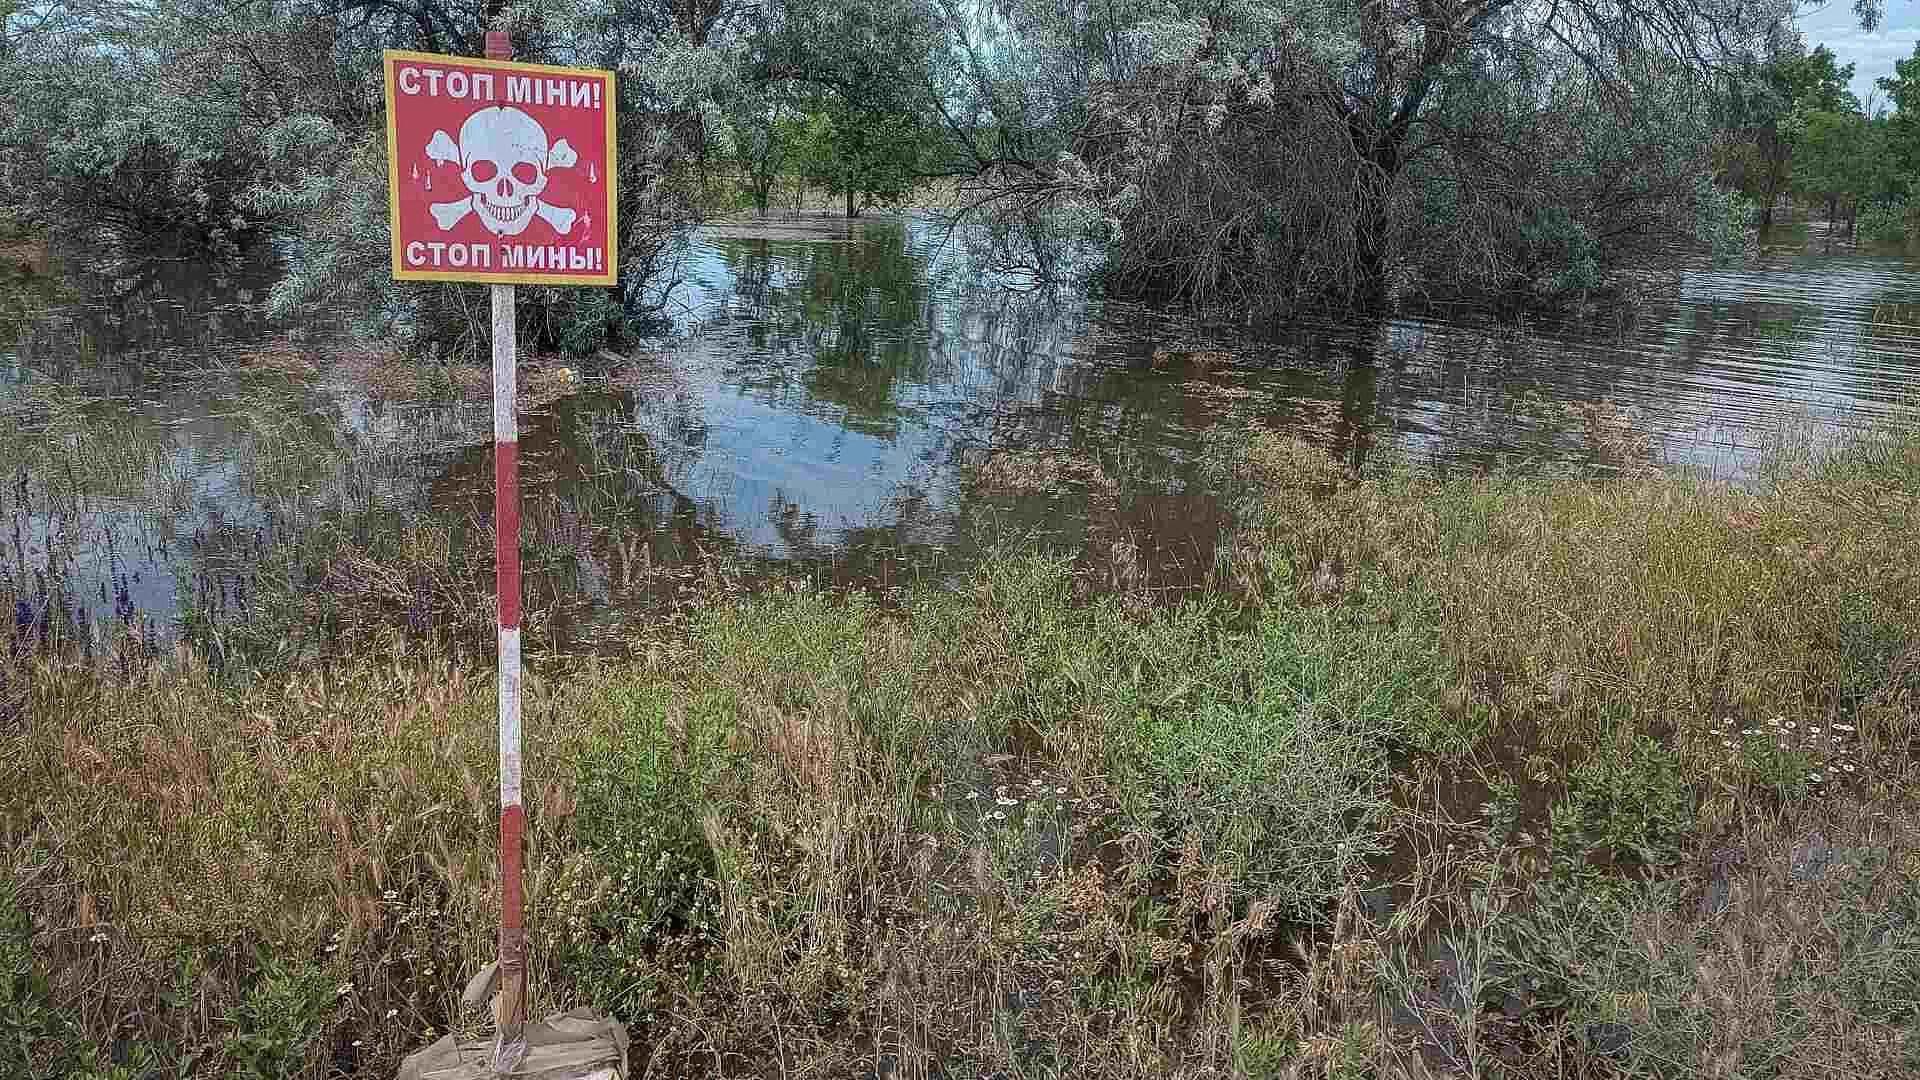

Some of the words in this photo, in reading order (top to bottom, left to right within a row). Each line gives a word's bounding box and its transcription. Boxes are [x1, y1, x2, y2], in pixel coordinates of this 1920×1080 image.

[399, 67, 496, 101] СТОП
[506, 76, 601, 109] МІНИ!
[406, 241, 490, 267] СТОП
[502, 244, 602, 270] МИНЫ!
